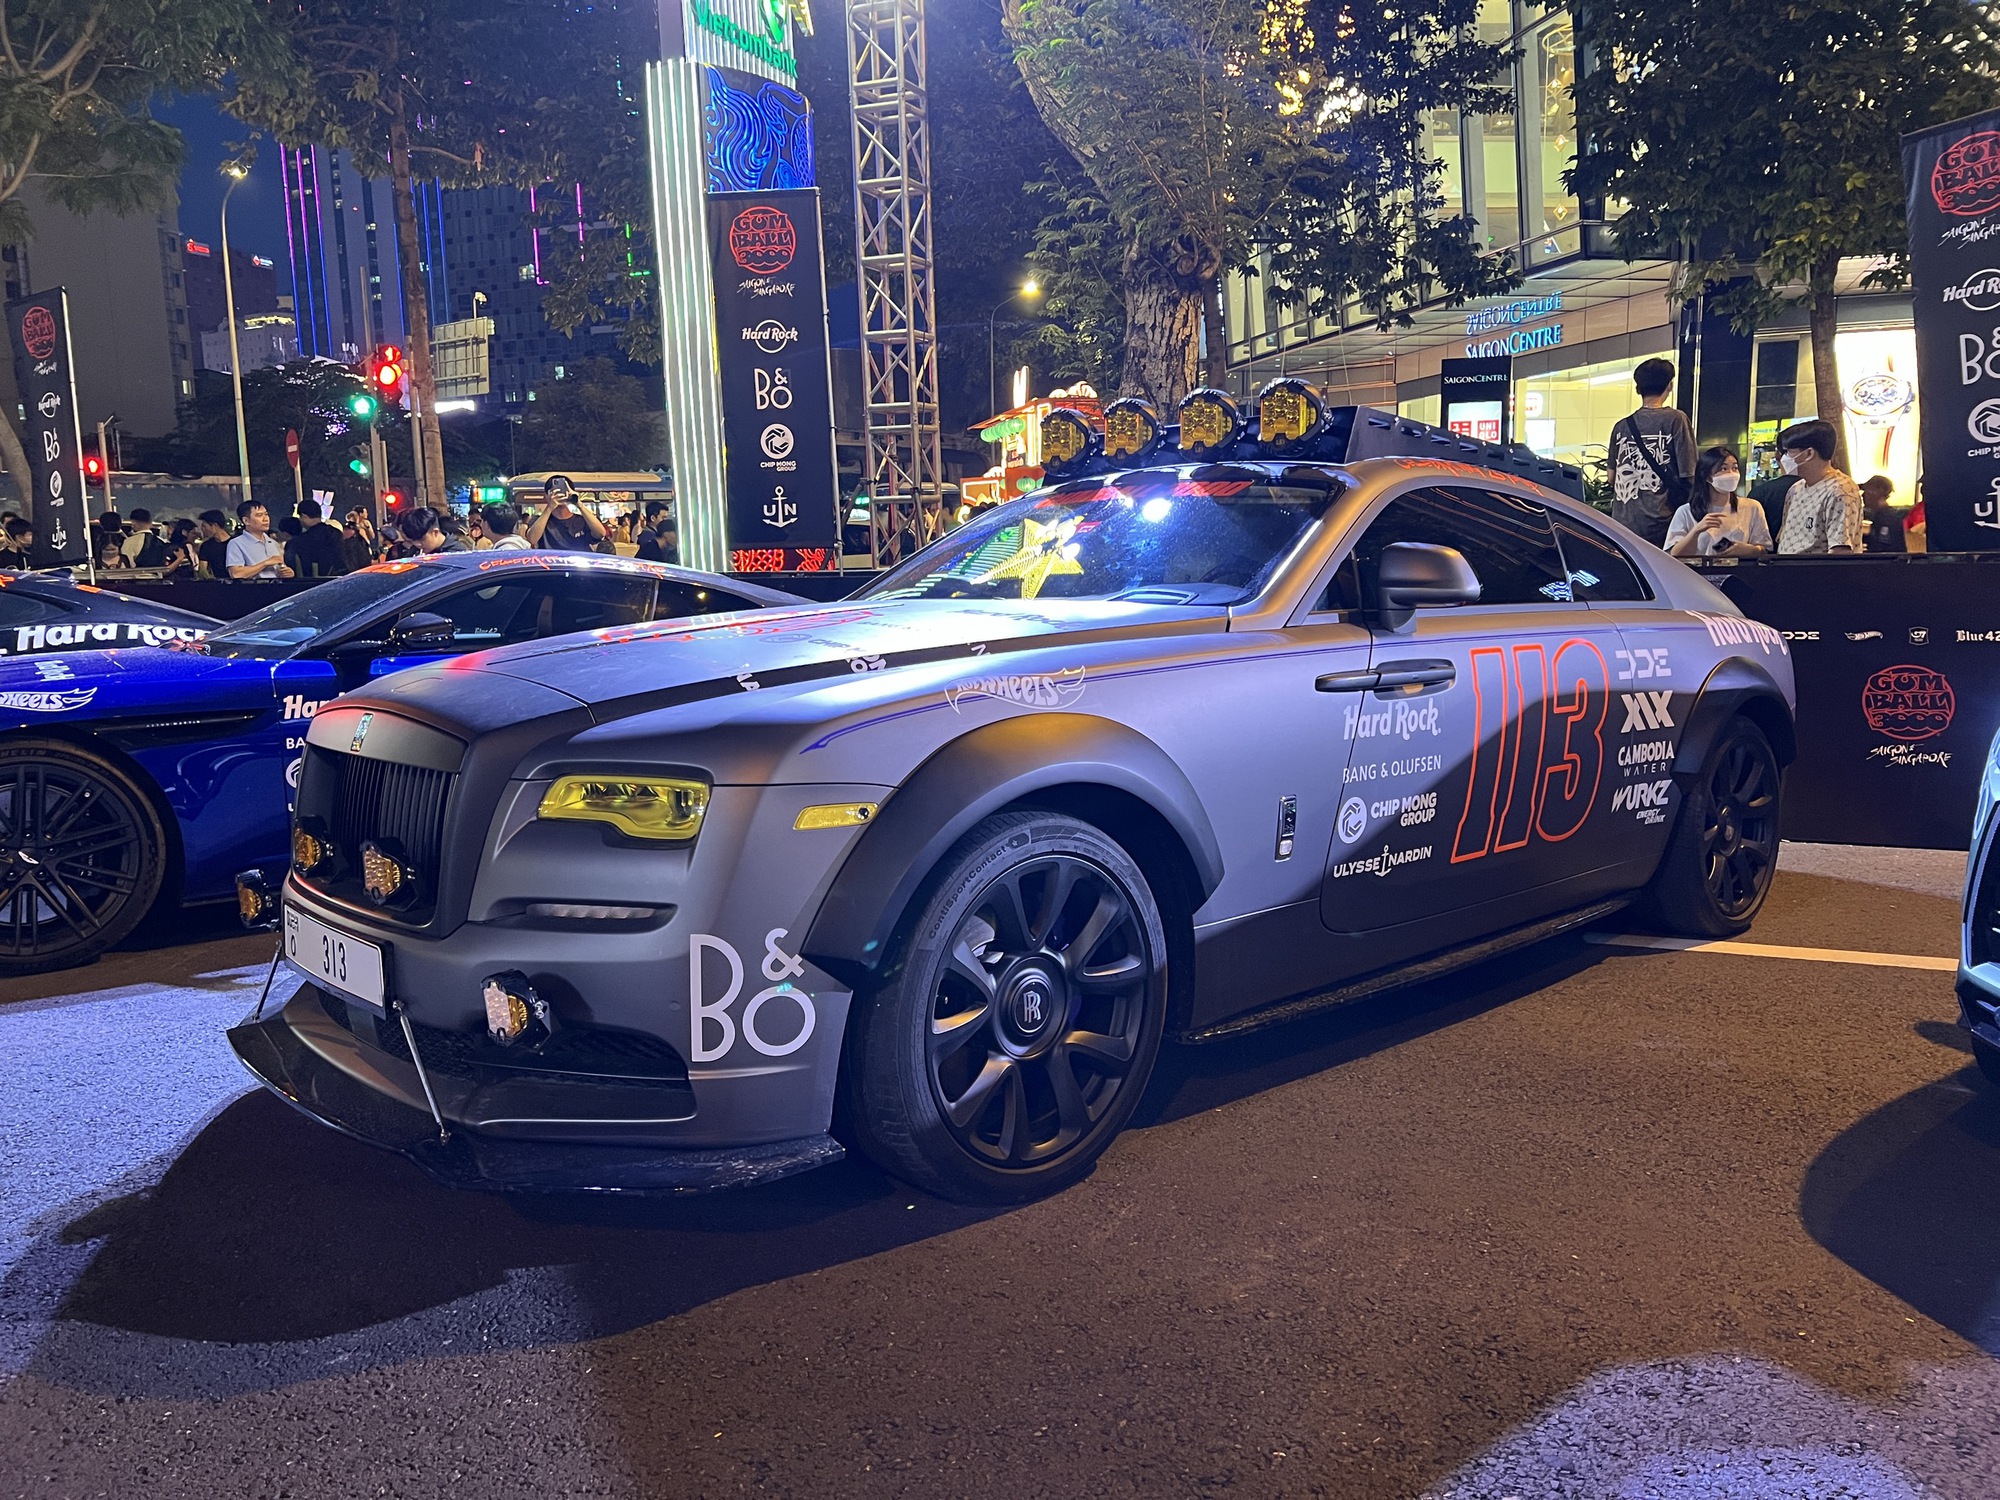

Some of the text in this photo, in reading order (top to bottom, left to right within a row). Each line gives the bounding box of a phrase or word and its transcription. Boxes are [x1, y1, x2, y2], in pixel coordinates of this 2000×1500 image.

[695, 0, 799, 79] Vietcombank
[733, 231, 792, 248] BALL
[1943, 280, 1986, 302] Hard
[742, 327, 798, 341] Hard Rock
[1479, 421, 1496, 430] UNI
[1968, 447, 1991, 457] CHIP
[14, 623, 118, 651] Hard
[1866, 692, 1950, 710] BALL
[1343, 700, 1393, 740] Hard
[1450, 638, 1610, 864] 113
[1618, 740, 1675, 767] CAMBODIA
[1866, 744, 1908, 760] SAIGON
[1885, 751, 1953, 768] SINGAPORE
[1343, 754, 1442, 784] BANG & OLUFSEN
[1624, 762, 1666, 777] WATER
[1371, 792, 1438, 819] CHIP MONG
[1611, 779, 1672, 813] WURKZ
[1401, 808, 1436, 827] GROUP
[1636, 808, 1661, 820] ENERGY
[1333, 845, 1432, 878] ULYSSE NARDIN
[323, 934, 347, 982] 313
